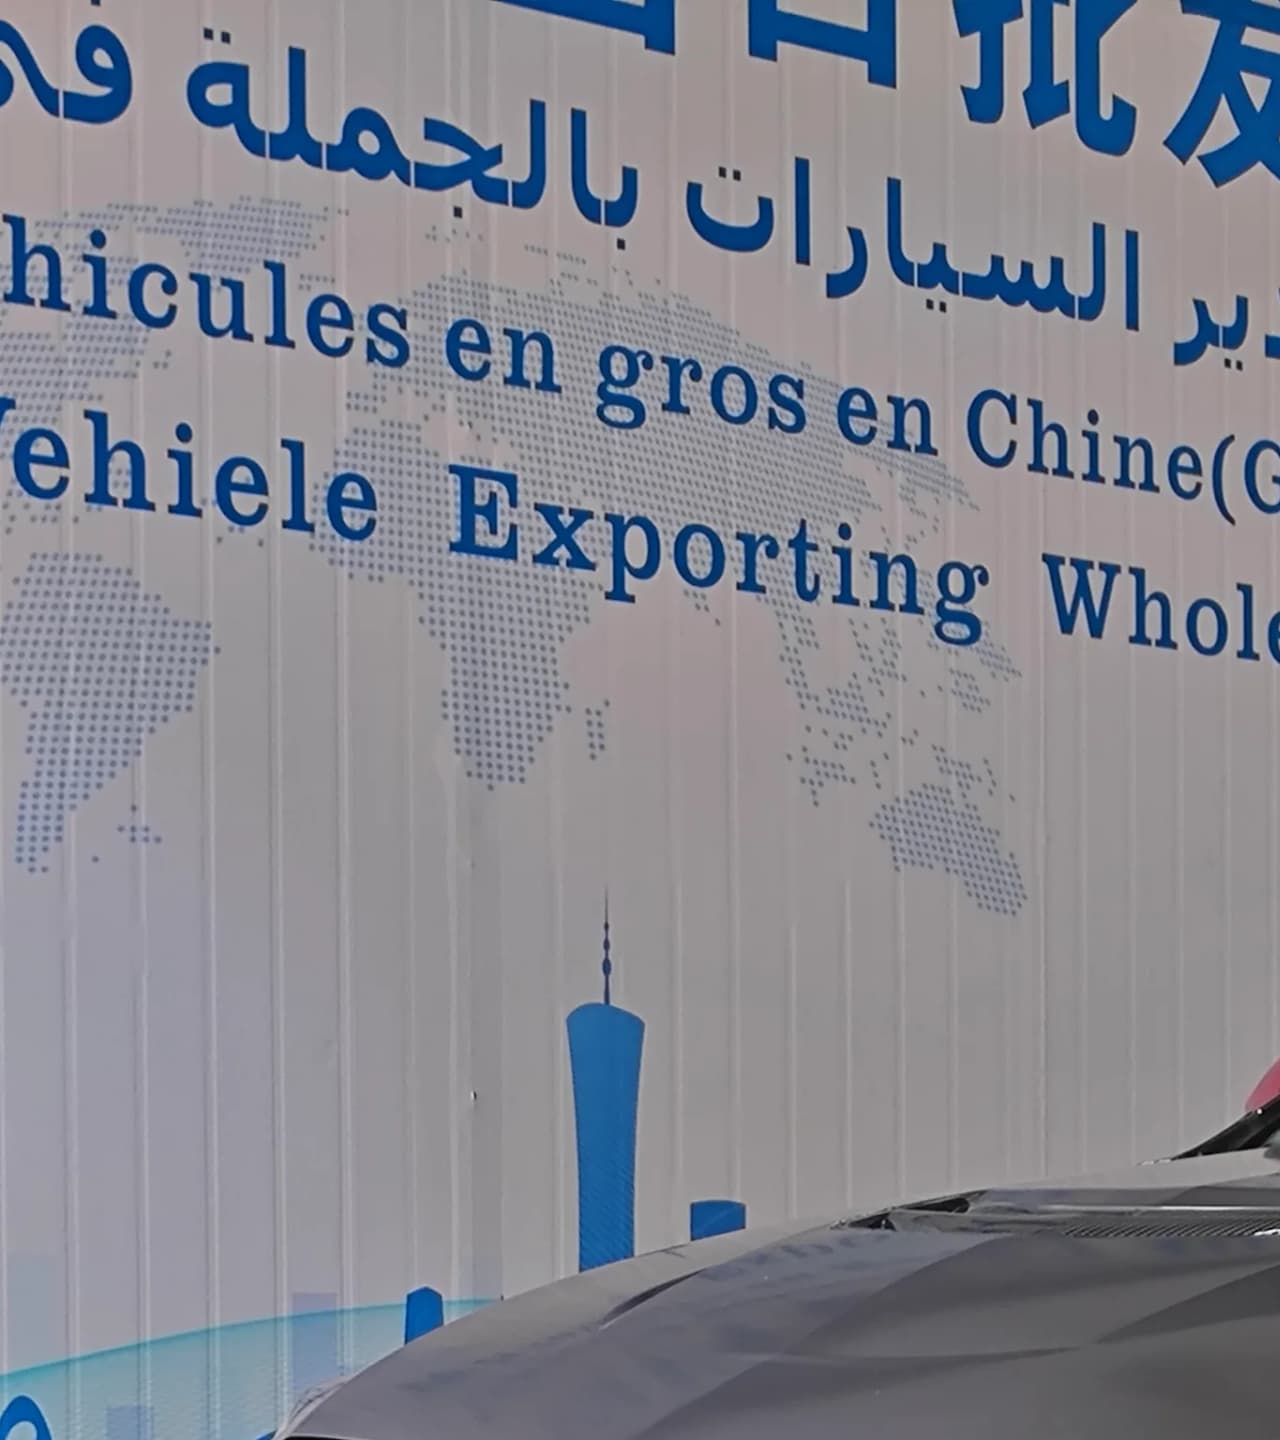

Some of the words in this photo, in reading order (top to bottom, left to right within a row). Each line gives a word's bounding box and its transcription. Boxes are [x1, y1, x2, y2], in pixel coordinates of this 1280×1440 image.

[184, 26, 640, 252] بالجملة
[685, 157, 1141, 332] السيارات
[1, 212, 411, 370] hicules
[443, 315, 563, 394] en
[595, 343, 808, 433] gros
[834, 385, 940, 457] en
[0, 393, 380, 546] ehiele
[446, 462, 990, 649] Exporting
